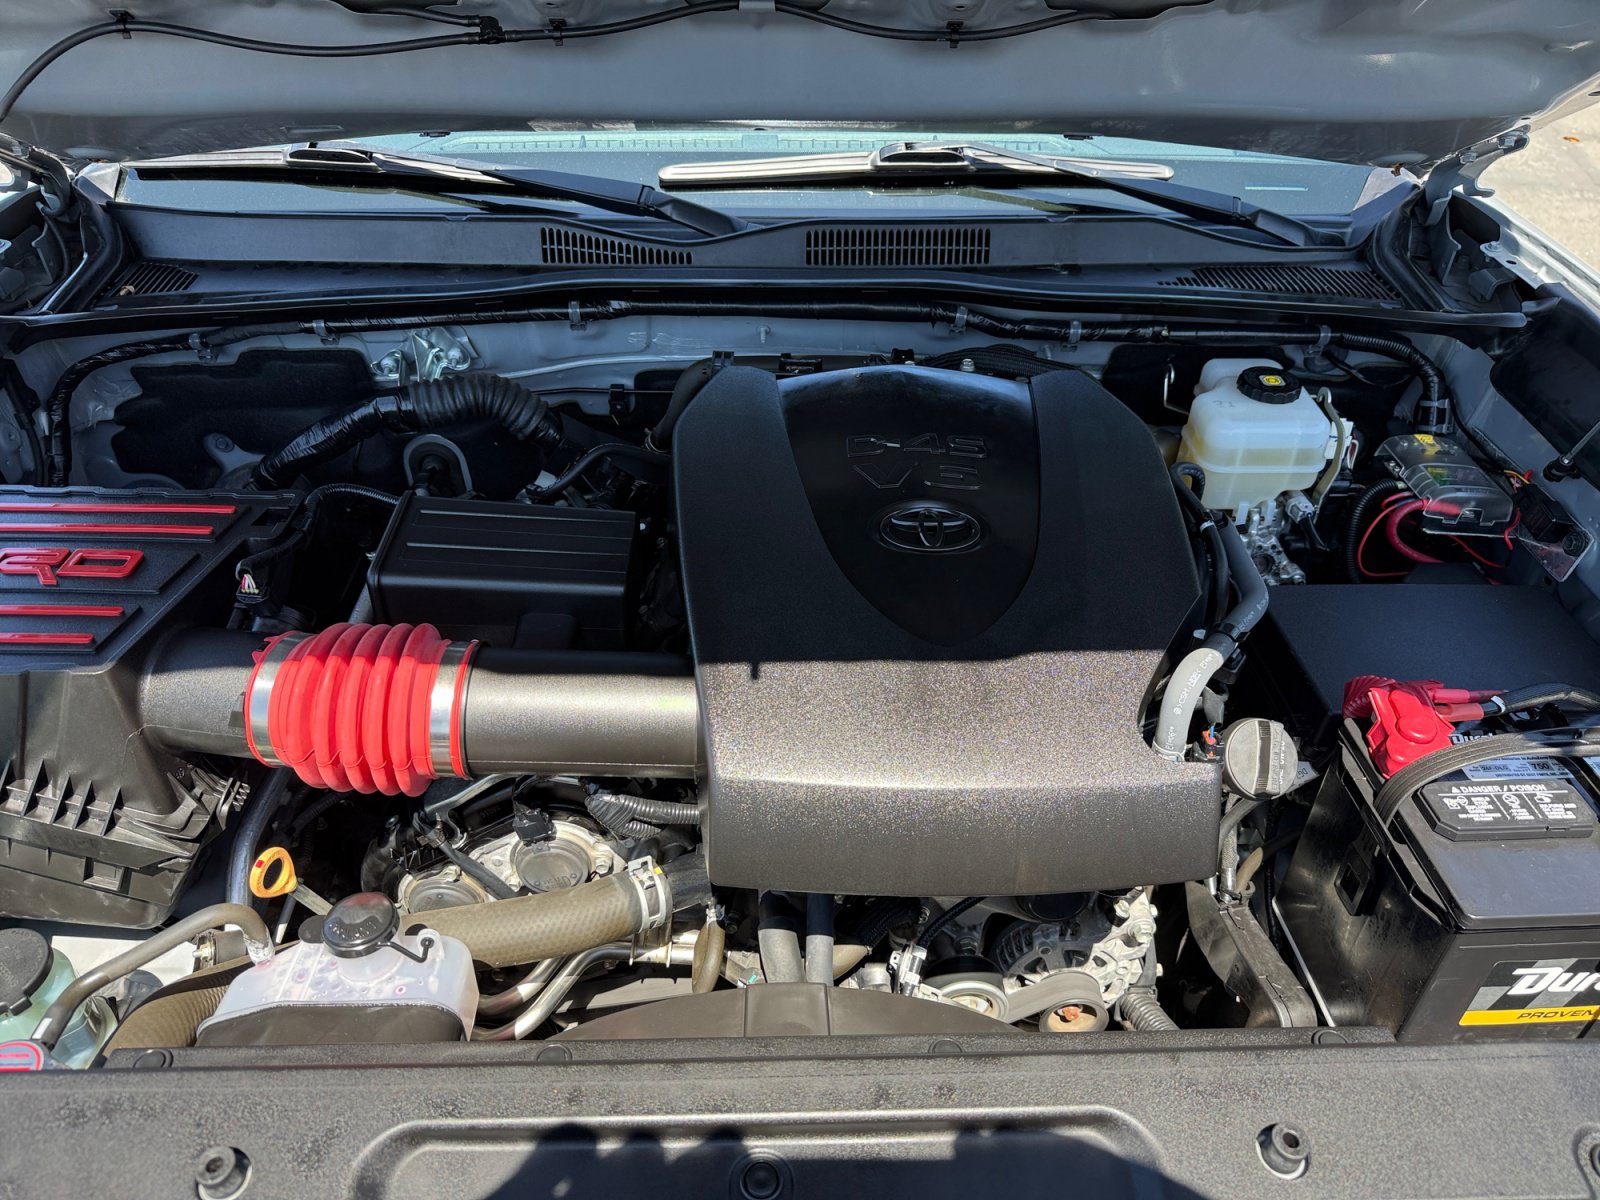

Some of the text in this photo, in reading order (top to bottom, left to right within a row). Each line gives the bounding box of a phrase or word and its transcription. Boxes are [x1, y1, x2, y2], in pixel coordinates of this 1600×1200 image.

[846, 433, 987, 458] D-4S
[1460, 785, 1502, 793] DANGER
[1509, 784, 1547, 792] POISON
[1507, 967, 1600, 995] Dur
[1517, 1010, 1594, 1019] PROVEN
